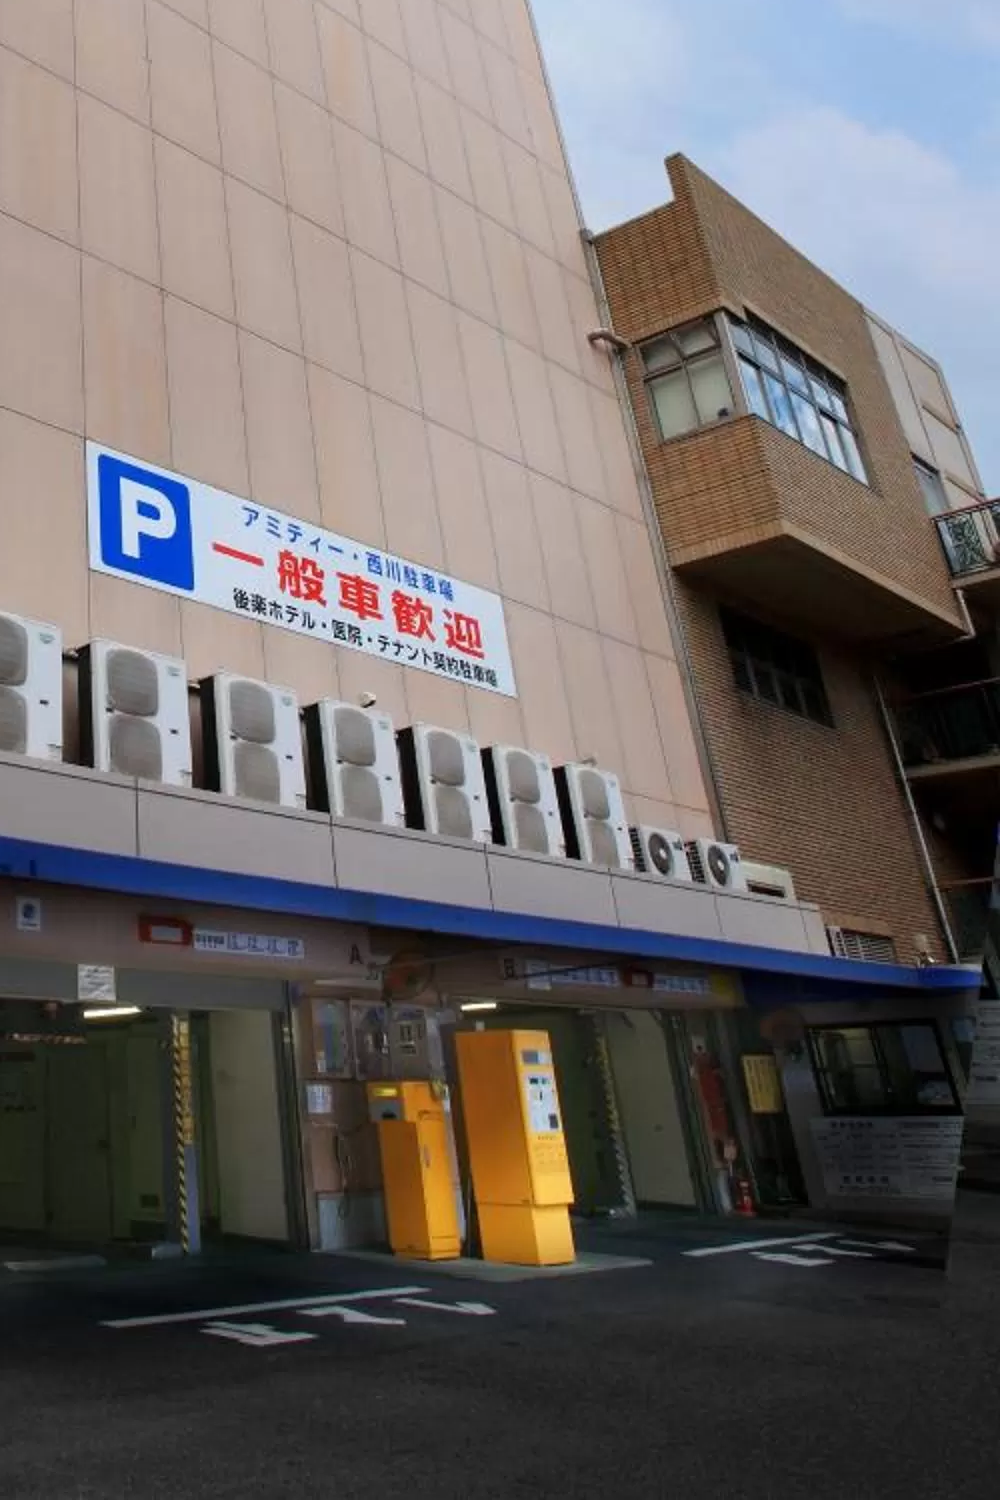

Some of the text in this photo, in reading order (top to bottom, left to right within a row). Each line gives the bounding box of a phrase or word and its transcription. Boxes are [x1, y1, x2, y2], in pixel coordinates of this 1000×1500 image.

[119, 476, 177, 559] P
[241, 505, 454, 602] アミティー・西川駐車場
[212, 542, 485, 659] 一般車歓迎
[349, 944, 364, 965] A
